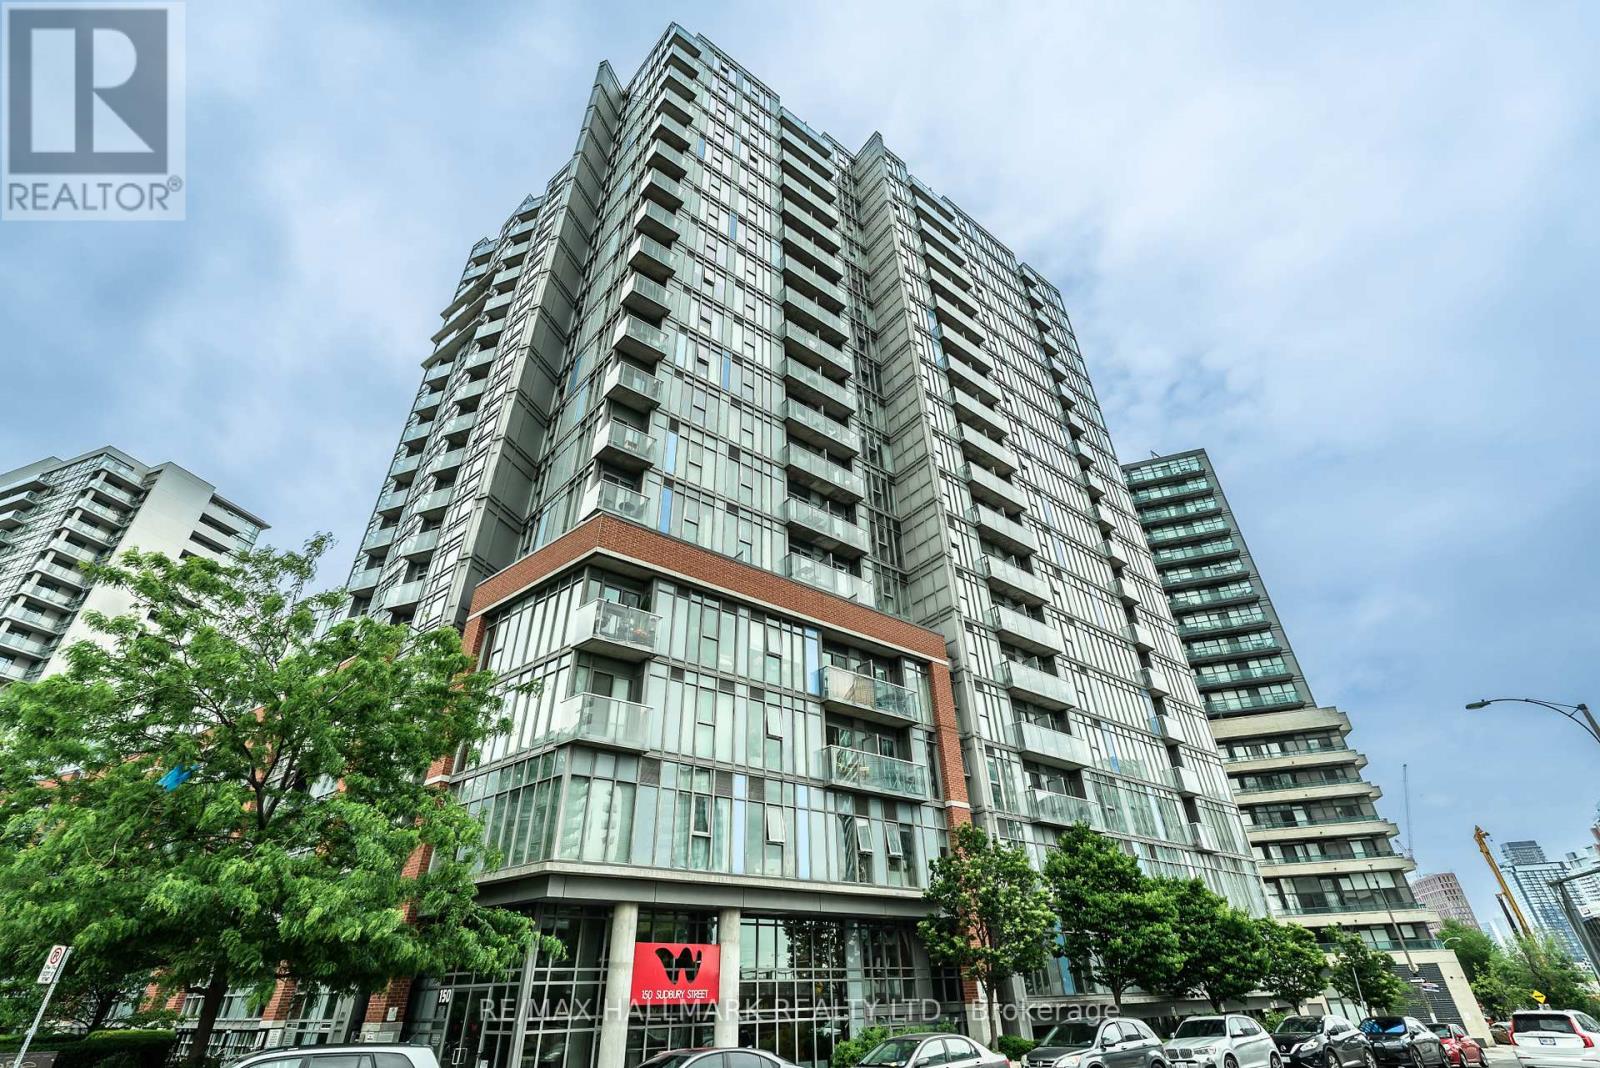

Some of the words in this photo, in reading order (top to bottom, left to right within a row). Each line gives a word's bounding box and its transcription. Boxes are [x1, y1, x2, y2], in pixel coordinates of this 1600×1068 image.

[438, 988, 452, 1003] 150
[641, 989, 653, 999] 150
[655, 989, 685, 999] SUDBURY
[687, 989, 708, 998] STREET
